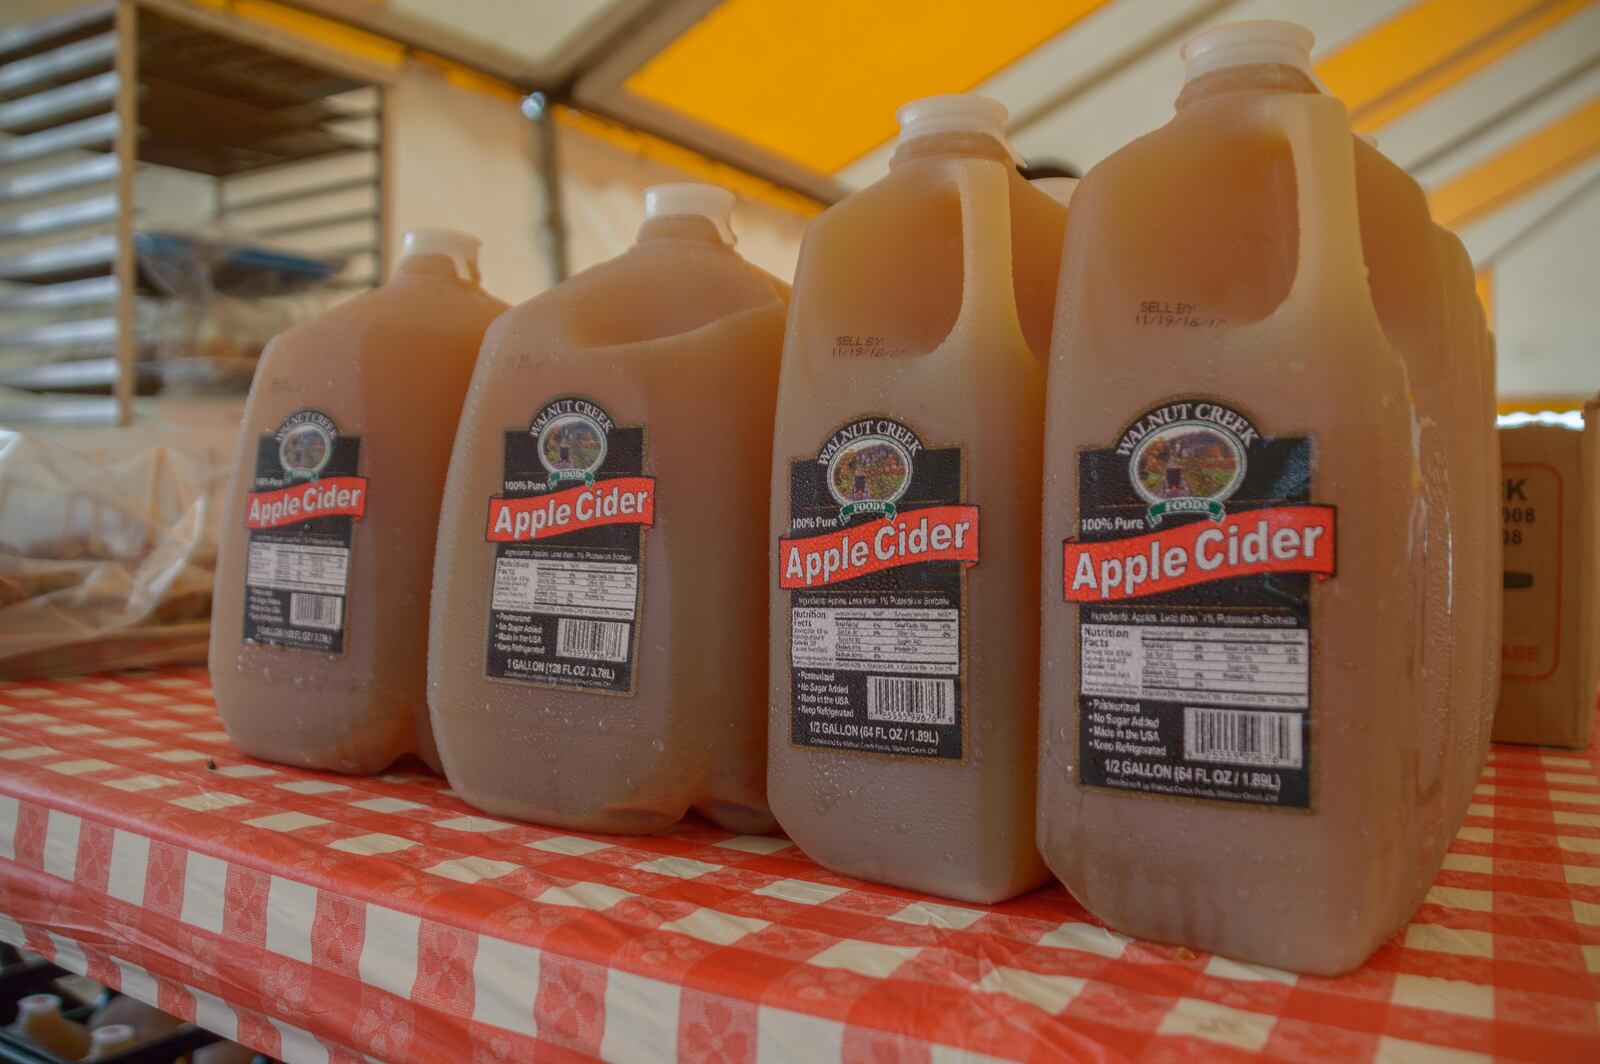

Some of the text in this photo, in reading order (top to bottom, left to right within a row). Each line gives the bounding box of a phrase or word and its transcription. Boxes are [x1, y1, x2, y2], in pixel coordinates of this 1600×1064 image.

[1140, 300, 1197, 314] SELL BY
[836, 335, 862, 346] SELL
[530, 400, 614, 438] WALNUT CREEK
[1116, 403, 1260, 458] WALNUT CREEK
[817, 420, 923, 466] WALNUT CREEK
[559, 470, 586, 479] FOODS
[504, 480, 547, 491] 100% Pure
[1502, 478, 1529, 501] K
[248, 484, 361, 528] Apple Cider
[853, 502, 885, 512] FOODS
[1165, 499, 1210, 512] FOODS
[494, 486, 649, 540] Apple Cider
[792, 516, 838, 530] 100% Pure
[1081, 516, 1145, 532] 100% Pure
[785, 518, 970, 585] Apple Cider
[499, 560, 529, 569] Nutrition
[1071, 520, 1324, 599] Apple Cider
[793, 609, 826, 619] Nutrition
[793, 619, 812, 628] Facts
[528, 635, 542, 643] USA
[1084, 626, 1129, 639] Nutrition
[1084, 637, 1109, 648] Facts
[512, 659, 544, 672] GALLON
[545, 662, 561, 674] (128
[562, 664, 572, 675] FL
[573, 665, 585, 676] OZ
[590, 667, 615, 681] 3.78L)
[801, 683, 849, 694] No Sugar Added
[801, 694, 816, 703] Made
[823, 695, 834, 704] the
[834, 696, 849, 706] USA
[1092, 698, 1140, 713] Pasteurized
[801, 704, 854, 718] Keep Refrigerated
[1093, 712, 1160, 729] No Sugar Added
[809, 721, 821, 733] 1/2
[822, 723, 859, 737] GALLON
[859, 726, 874, 738] (64
[875, 727, 887, 739] FL
[888, 728, 903, 740] OZ
[909, 729, 939, 746] 1.89L)
[1093, 725, 1160, 742] Made in the USA
[1093, 738, 1167, 756] Keep Refrigerated
[1104, 757, 1120, 773] 1/2
[1121, 760, 1172, 779] GALLON
[1173, 765, 1193, 783] (64
[1194, 767, 1212, 783] FL
[1212, 769, 1233, 786] OZ
[1241, 772, 1281, 793] 1.89L)
